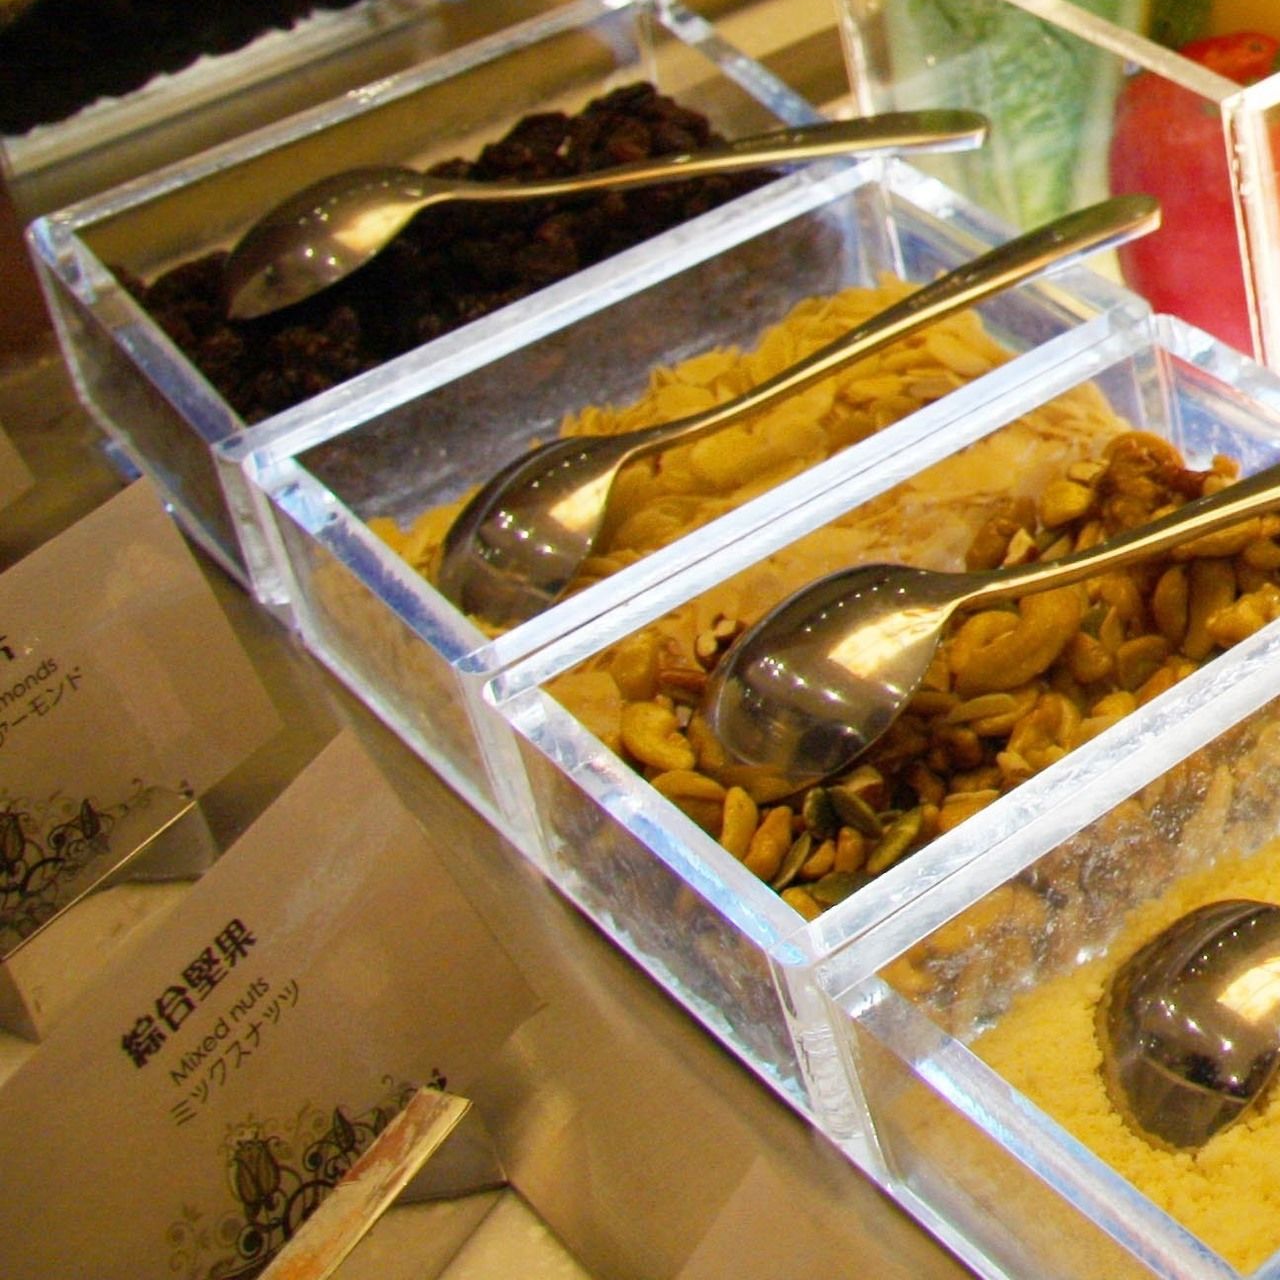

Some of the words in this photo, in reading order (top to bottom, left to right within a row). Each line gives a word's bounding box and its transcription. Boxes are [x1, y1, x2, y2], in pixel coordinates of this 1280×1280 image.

[121, 918, 256, 1069] 綜合堅果
[170, 1017, 231, 1086] Mixed
[229, 977, 270, 1023] nuts
[170, 979, 299, 1126] ミックスナッツ
